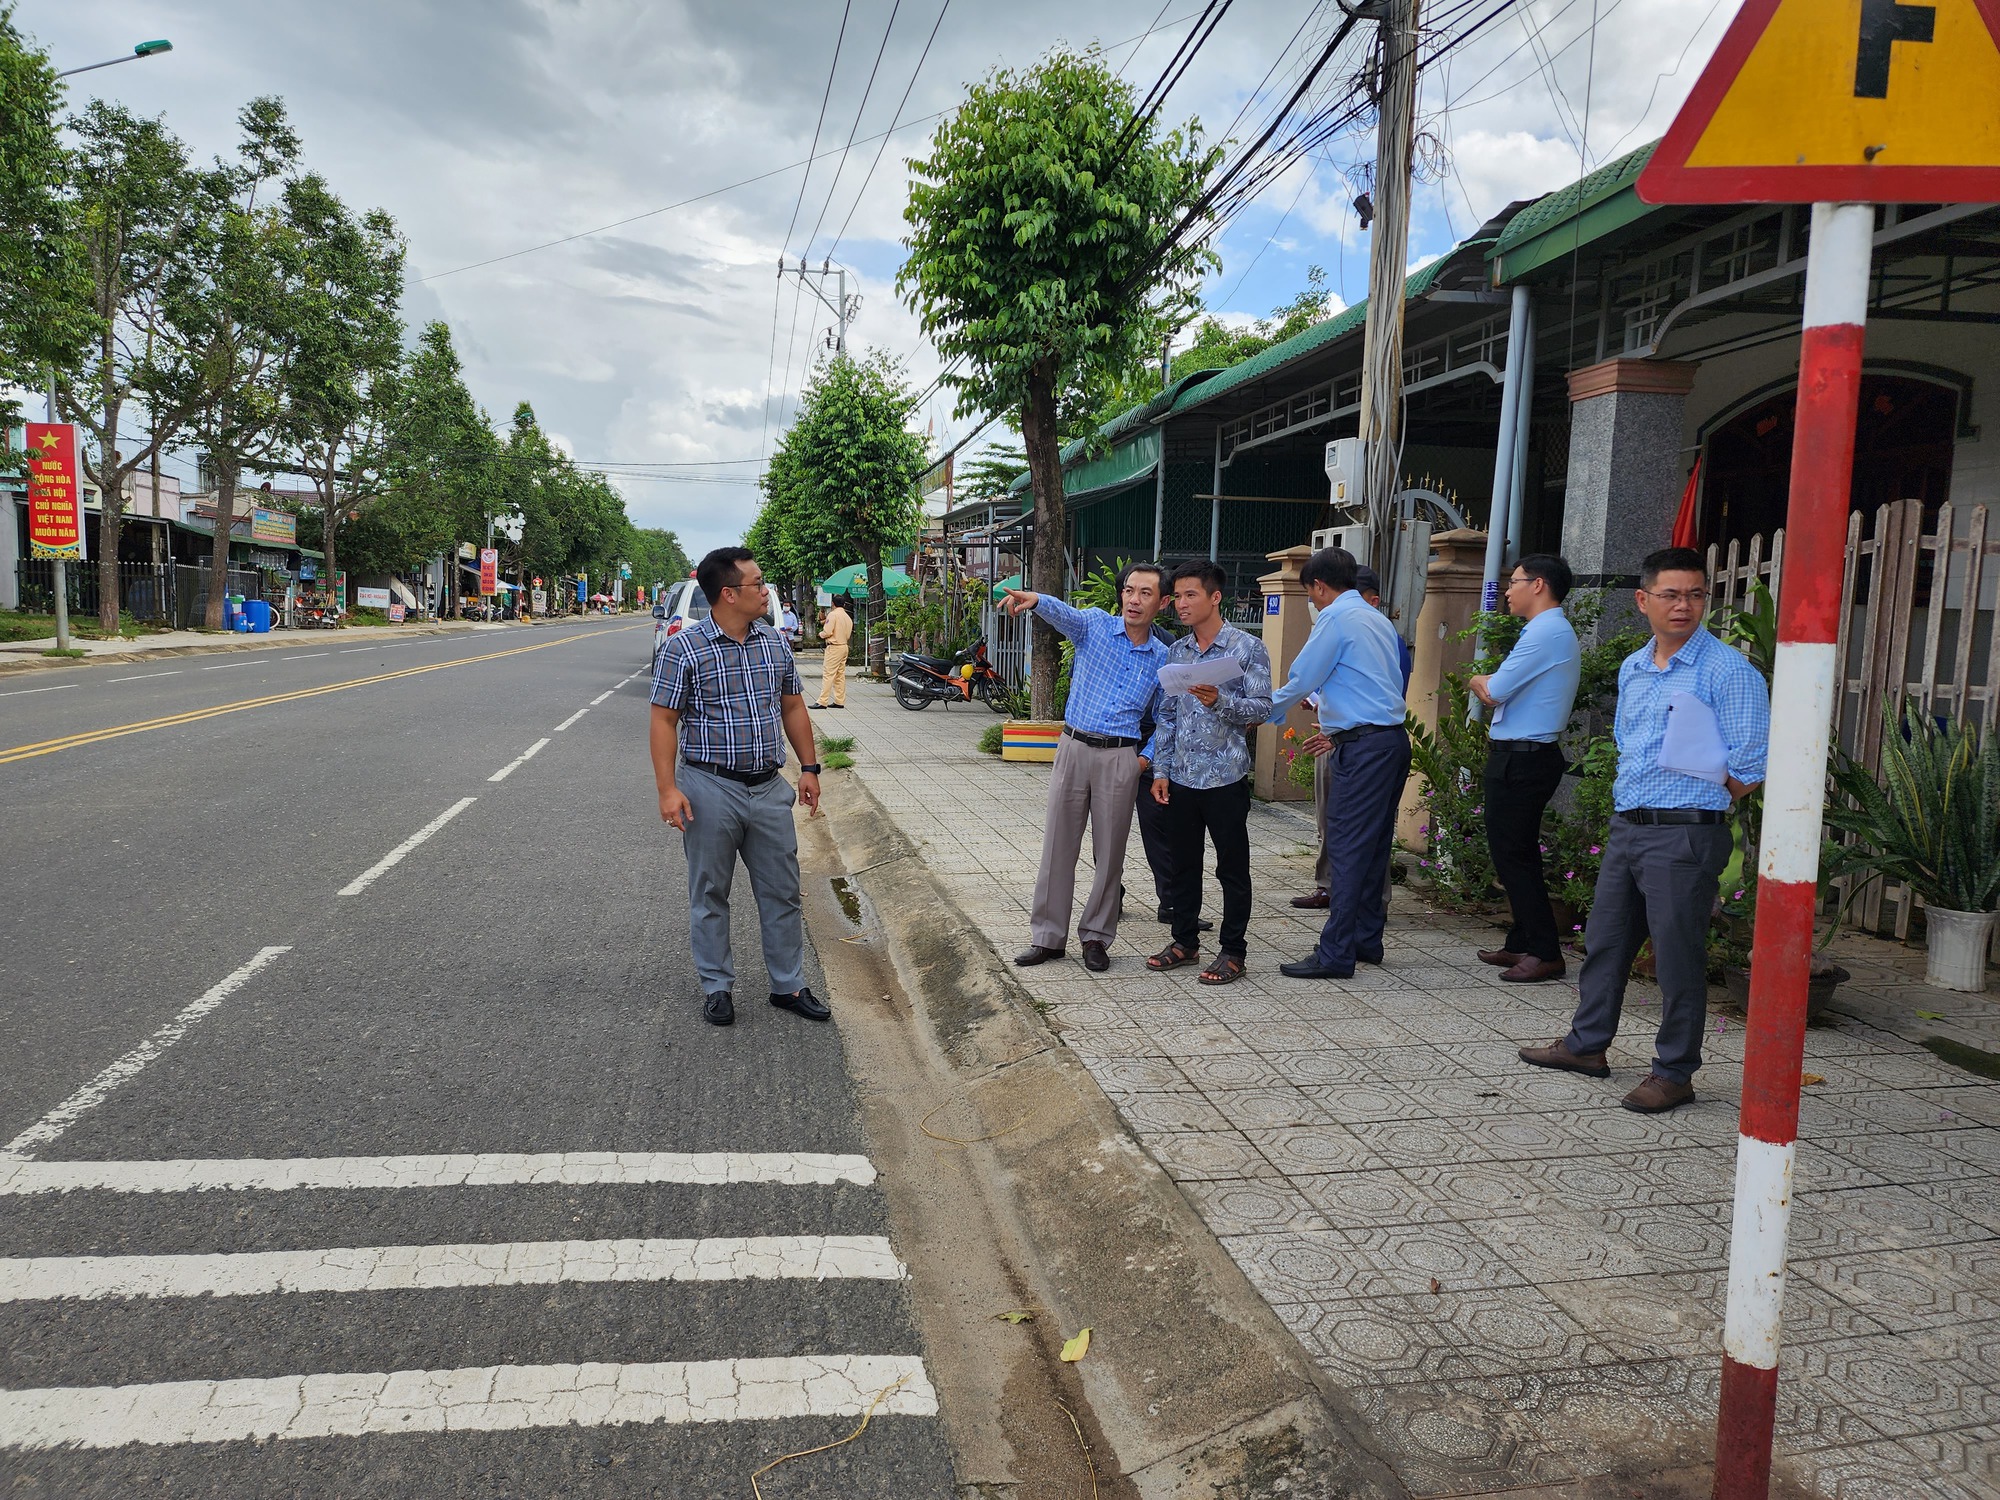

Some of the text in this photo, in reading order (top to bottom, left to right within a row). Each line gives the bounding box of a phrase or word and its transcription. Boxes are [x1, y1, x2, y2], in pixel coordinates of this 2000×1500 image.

[42, 461, 62, 470] NƯỚC
[55, 474, 71, 484] HÒA
[53, 487, 66, 499] HỘI
[35, 499, 73, 511] CHỦ NGHĨA
[37, 513, 73, 525] VIỆT NAM
[35, 526, 76, 538] MUÔN NĂM
[1269, 597, 1278, 607] 430
